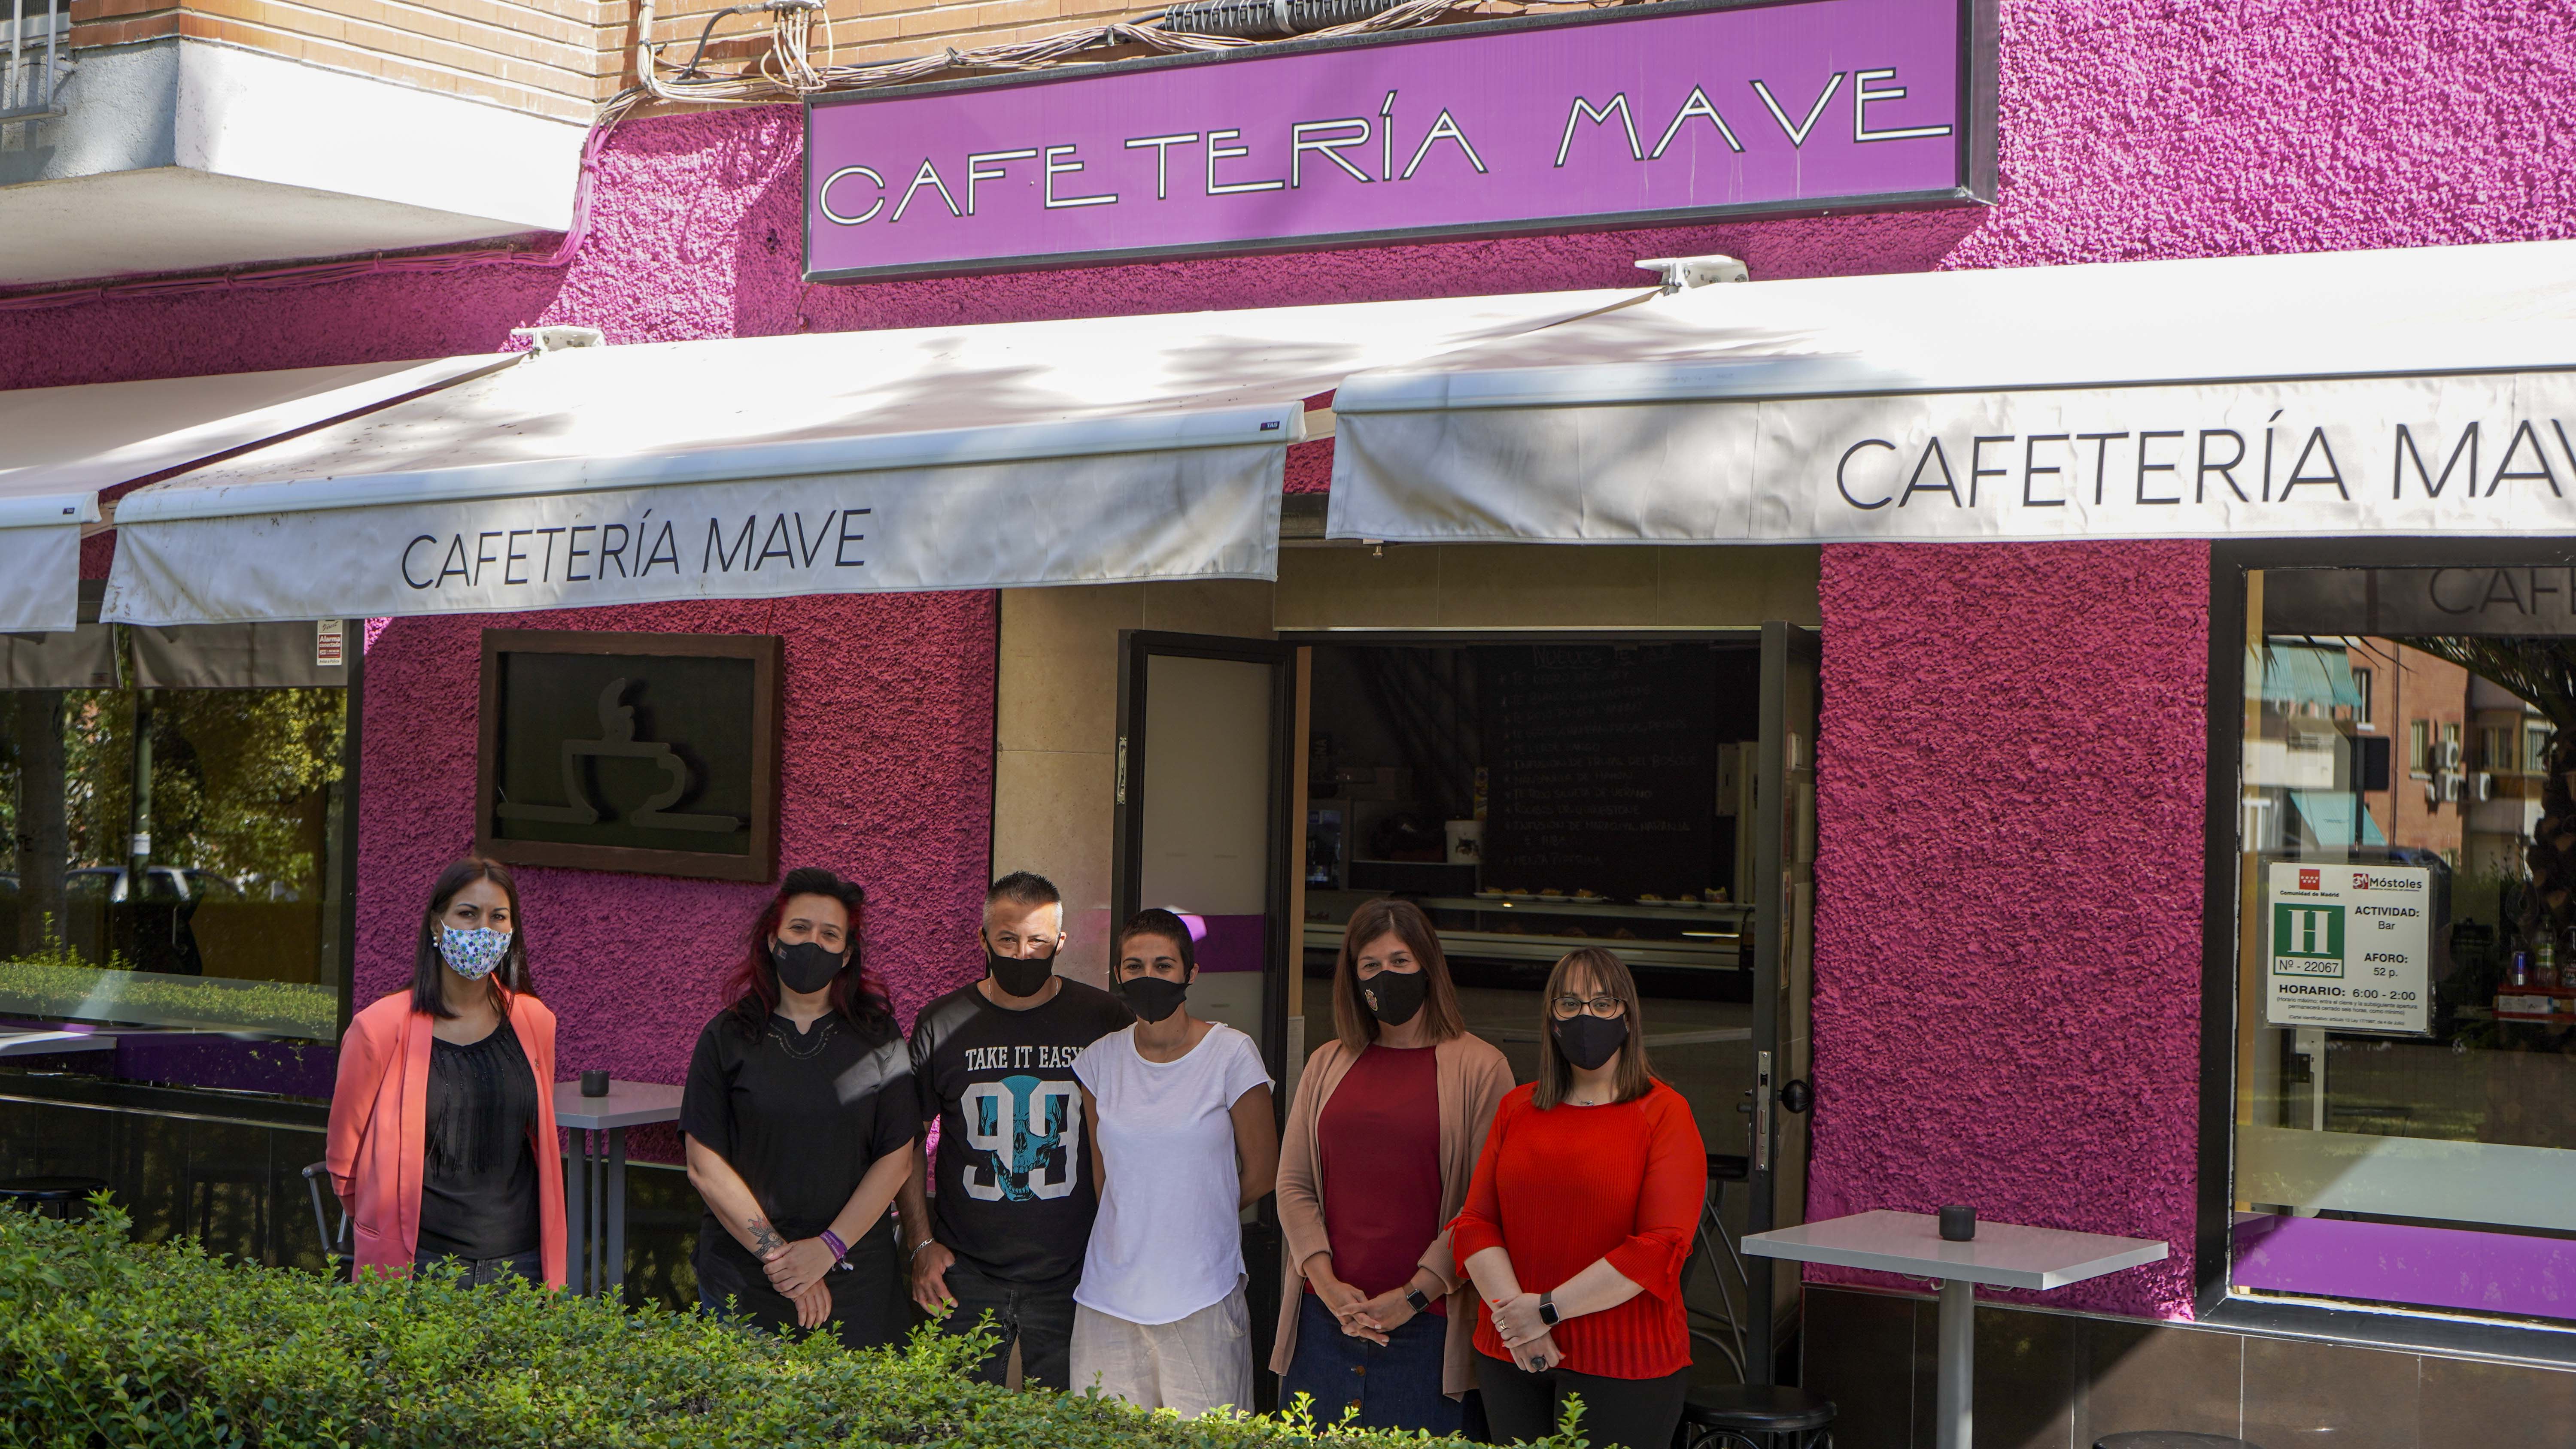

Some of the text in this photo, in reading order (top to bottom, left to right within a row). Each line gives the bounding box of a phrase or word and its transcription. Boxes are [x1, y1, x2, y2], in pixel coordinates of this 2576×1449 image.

[818, 66, 1953, 227] CAFETERÍA MAVE
[1837, 409, 2350, 510] CAFETERÍA
[402, 508, 872, 589] CAFETERÍA MAVE
[2430, 568, 2576, 614] CAF
[2370, 878, 2422, 888] Móstoles
[2355, 906, 2419, 917] ACTIVIDAD:
[2287, 909, 2332, 955] H
[2378, 921, 2395, 930] Bar
[2304, 961, 2339, 973] 22067
[2364, 953, 2408, 964] AFORO:
[2373, 967, 2398, 978] 52 p.
[2279, 984, 2345, 996] HORARIO:
[2353, 989, 2378, 998] 6:00
[2390, 991, 2415, 1000] 2:00
[965, 1046, 1008, 1071] TAKE
[1014, 1046, 1033, 1068] IT
[961, 1081, 1082, 1201] 99
